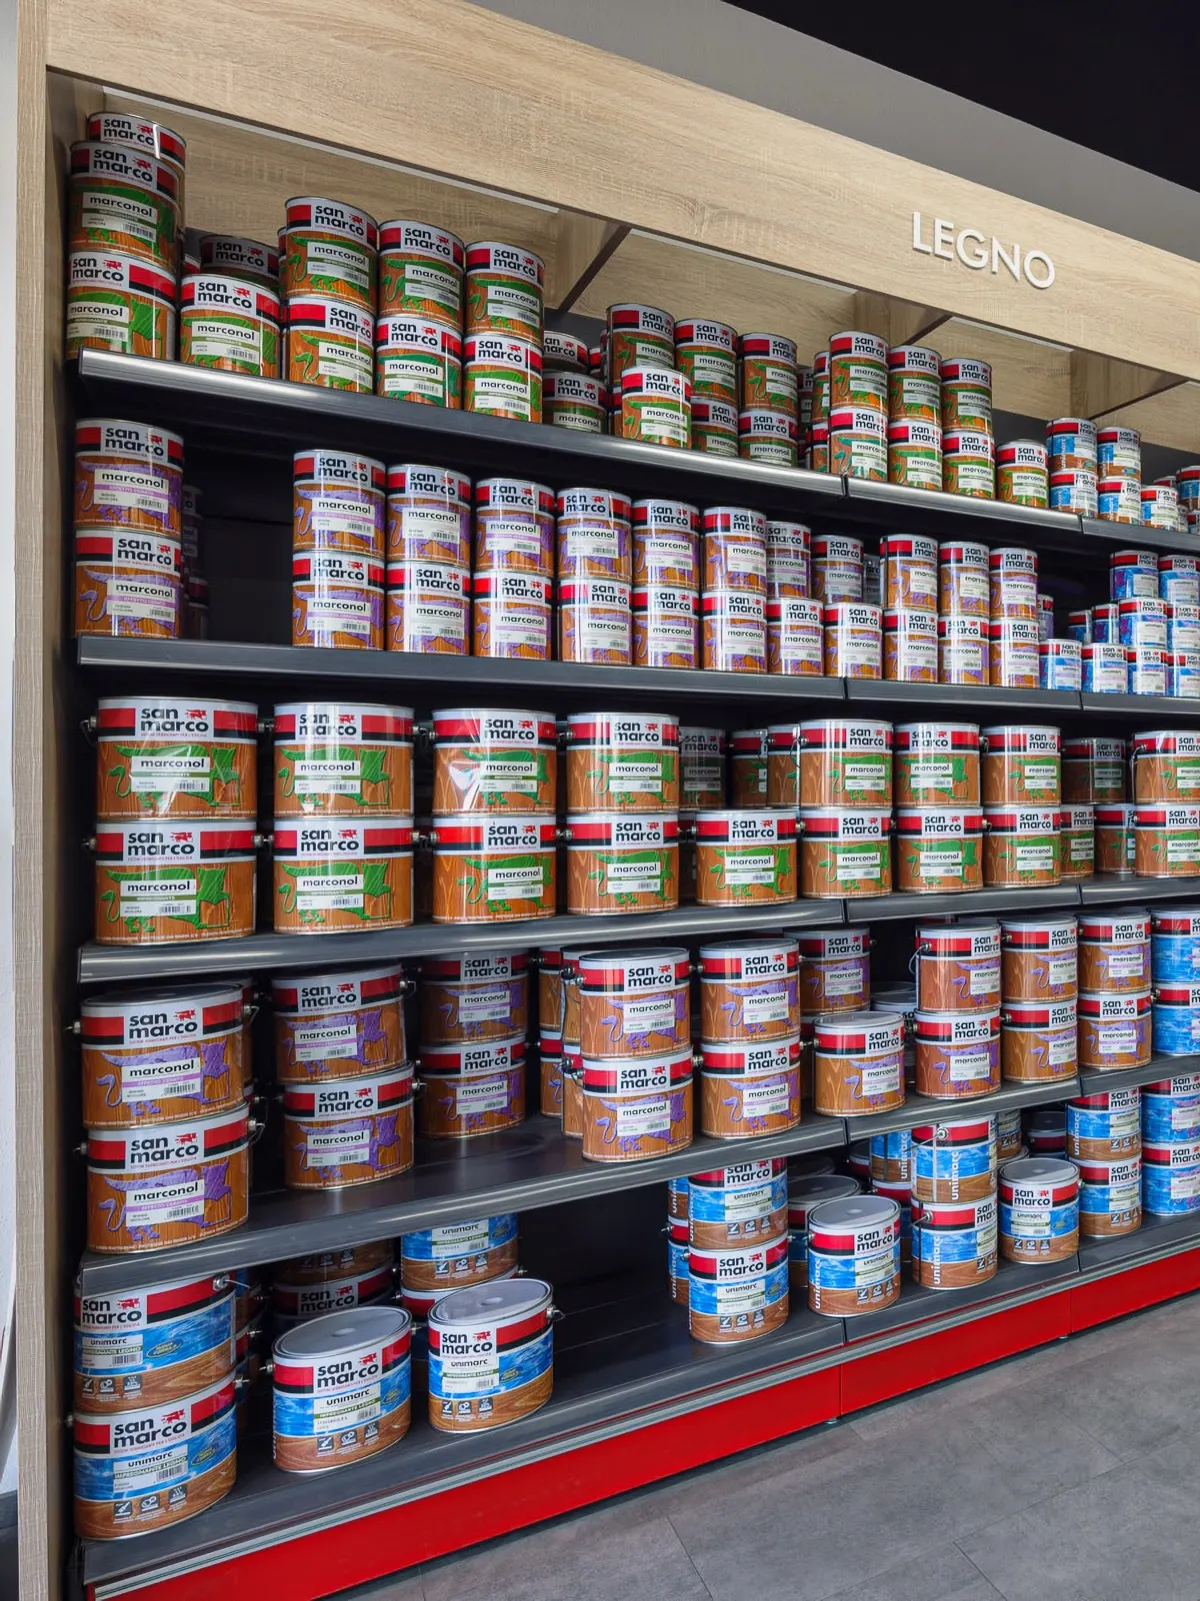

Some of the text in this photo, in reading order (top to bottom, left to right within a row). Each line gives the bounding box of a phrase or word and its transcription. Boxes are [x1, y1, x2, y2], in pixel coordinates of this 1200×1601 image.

[104, 118, 131, 129] san
[103, 127, 155, 146] marco
[93, 148, 126, 163] san
[93, 159, 153, 183] marco
[90, 195, 152, 218] marconol
[315, 204, 344, 218] san
[315, 215, 364, 237] marco
[405, 226, 432, 240] san
[215, 241, 242, 252] san
[404, 237, 451, 256] marco
[912, 212, 1055, 289] LEGNO
[72, 256, 97, 268] san
[215, 250, 264, 267] marco
[314, 245, 366, 266] marconol
[72, 264, 124, 282] marco
[412, 267, 458, 289] marconol
[198, 281, 227, 293] san
[197, 292, 252, 309] marco
[197, 324, 255, 341] marconol
[391, 322, 417, 333] san
[391, 332, 438, 347] marco
[478, 339, 502, 349] san
[478, 349, 522, 364] marco
[389, 362, 439, 376] marconol
[481, 380, 527, 395] marconol
[106, 427, 139, 441] san
[105, 438, 164, 457] marco
[318, 456, 347, 468] san
[101, 471, 164, 489] marconol
[318, 467, 368, 483] marco
[410, 472, 436, 483] san
[409, 481, 455, 496] marco
[318, 500, 371, 514] marconol
[408, 510, 457, 523] marconol
[117, 537, 151, 551] san
[117, 549, 172, 566] marco
[502, 577, 527, 588] san
[116, 583, 173, 599] marconol
[501, 587, 543, 599] marco
[141, 708, 179, 719] san
[140, 719, 209, 733] marco
[850, 728, 871, 737] san
[850, 736, 884, 746] marco
[141, 758, 205, 768] marconol
[850, 765, 883, 774] marconol
[1019, 819, 1051, 829] marco
[1020, 813, 1039, 821] san
[301, 828, 331, 840] san
[488, 824, 517, 835] san
[128, 831, 163, 844] san
[488, 834, 537, 846] marco
[128, 843, 195, 856] marco
[300, 839, 359, 852] marco
[495, 868, 540, 879] marconol
[128, 881, 190, 892] marconol
[302, 876, 358, 887] marconol
[745, 962, 785, 974] marco
[746, 956, 768, 966] san
[1102, 1006, 1135, 1015] marco
[1103, 1000, 1121, 1008] san
[129, 1011, 167, 1027] san
[129, 1021, 198, 1039] marco
[129, 1060, 194, 1077] marconol
[319, 1090, 349, 1104] san
[318, 1097, 374, 1114] marco
[130, 1136, 168, 1152] san
[312, 1132, 365, 1145] marconol
[130, 1145, 199, 1164] marco
[133, 1182, 199, 1201] marconol
[1015, 1188, 1034, 1198] san
[1014, 1196, 1051, 1206] marco
[442, 1223, 479, 1235] unimarc
[719, 1256, 745, 1268] san
[718, 1262, 763, 1277] marco
[82, 1299, 111, 1312] san
[82, 1310, 142, 1325] marco
[90, 1337, 127, 1346] unimarc
[442, 1332, 467, 1344] san
[441, 1342, 492, 1355] marco
[318, 1359, 353, 1376] san
[451, 1358, 488, 1367] unimarc
[317, 1363, 379, 1388] marco
[326, 1389, 370, 1405] unimarc
[114, 1418, 154, 1436] san
[114, 1421, 187, 1449] marco
[128, 1450, 173, 1467] unimarc
